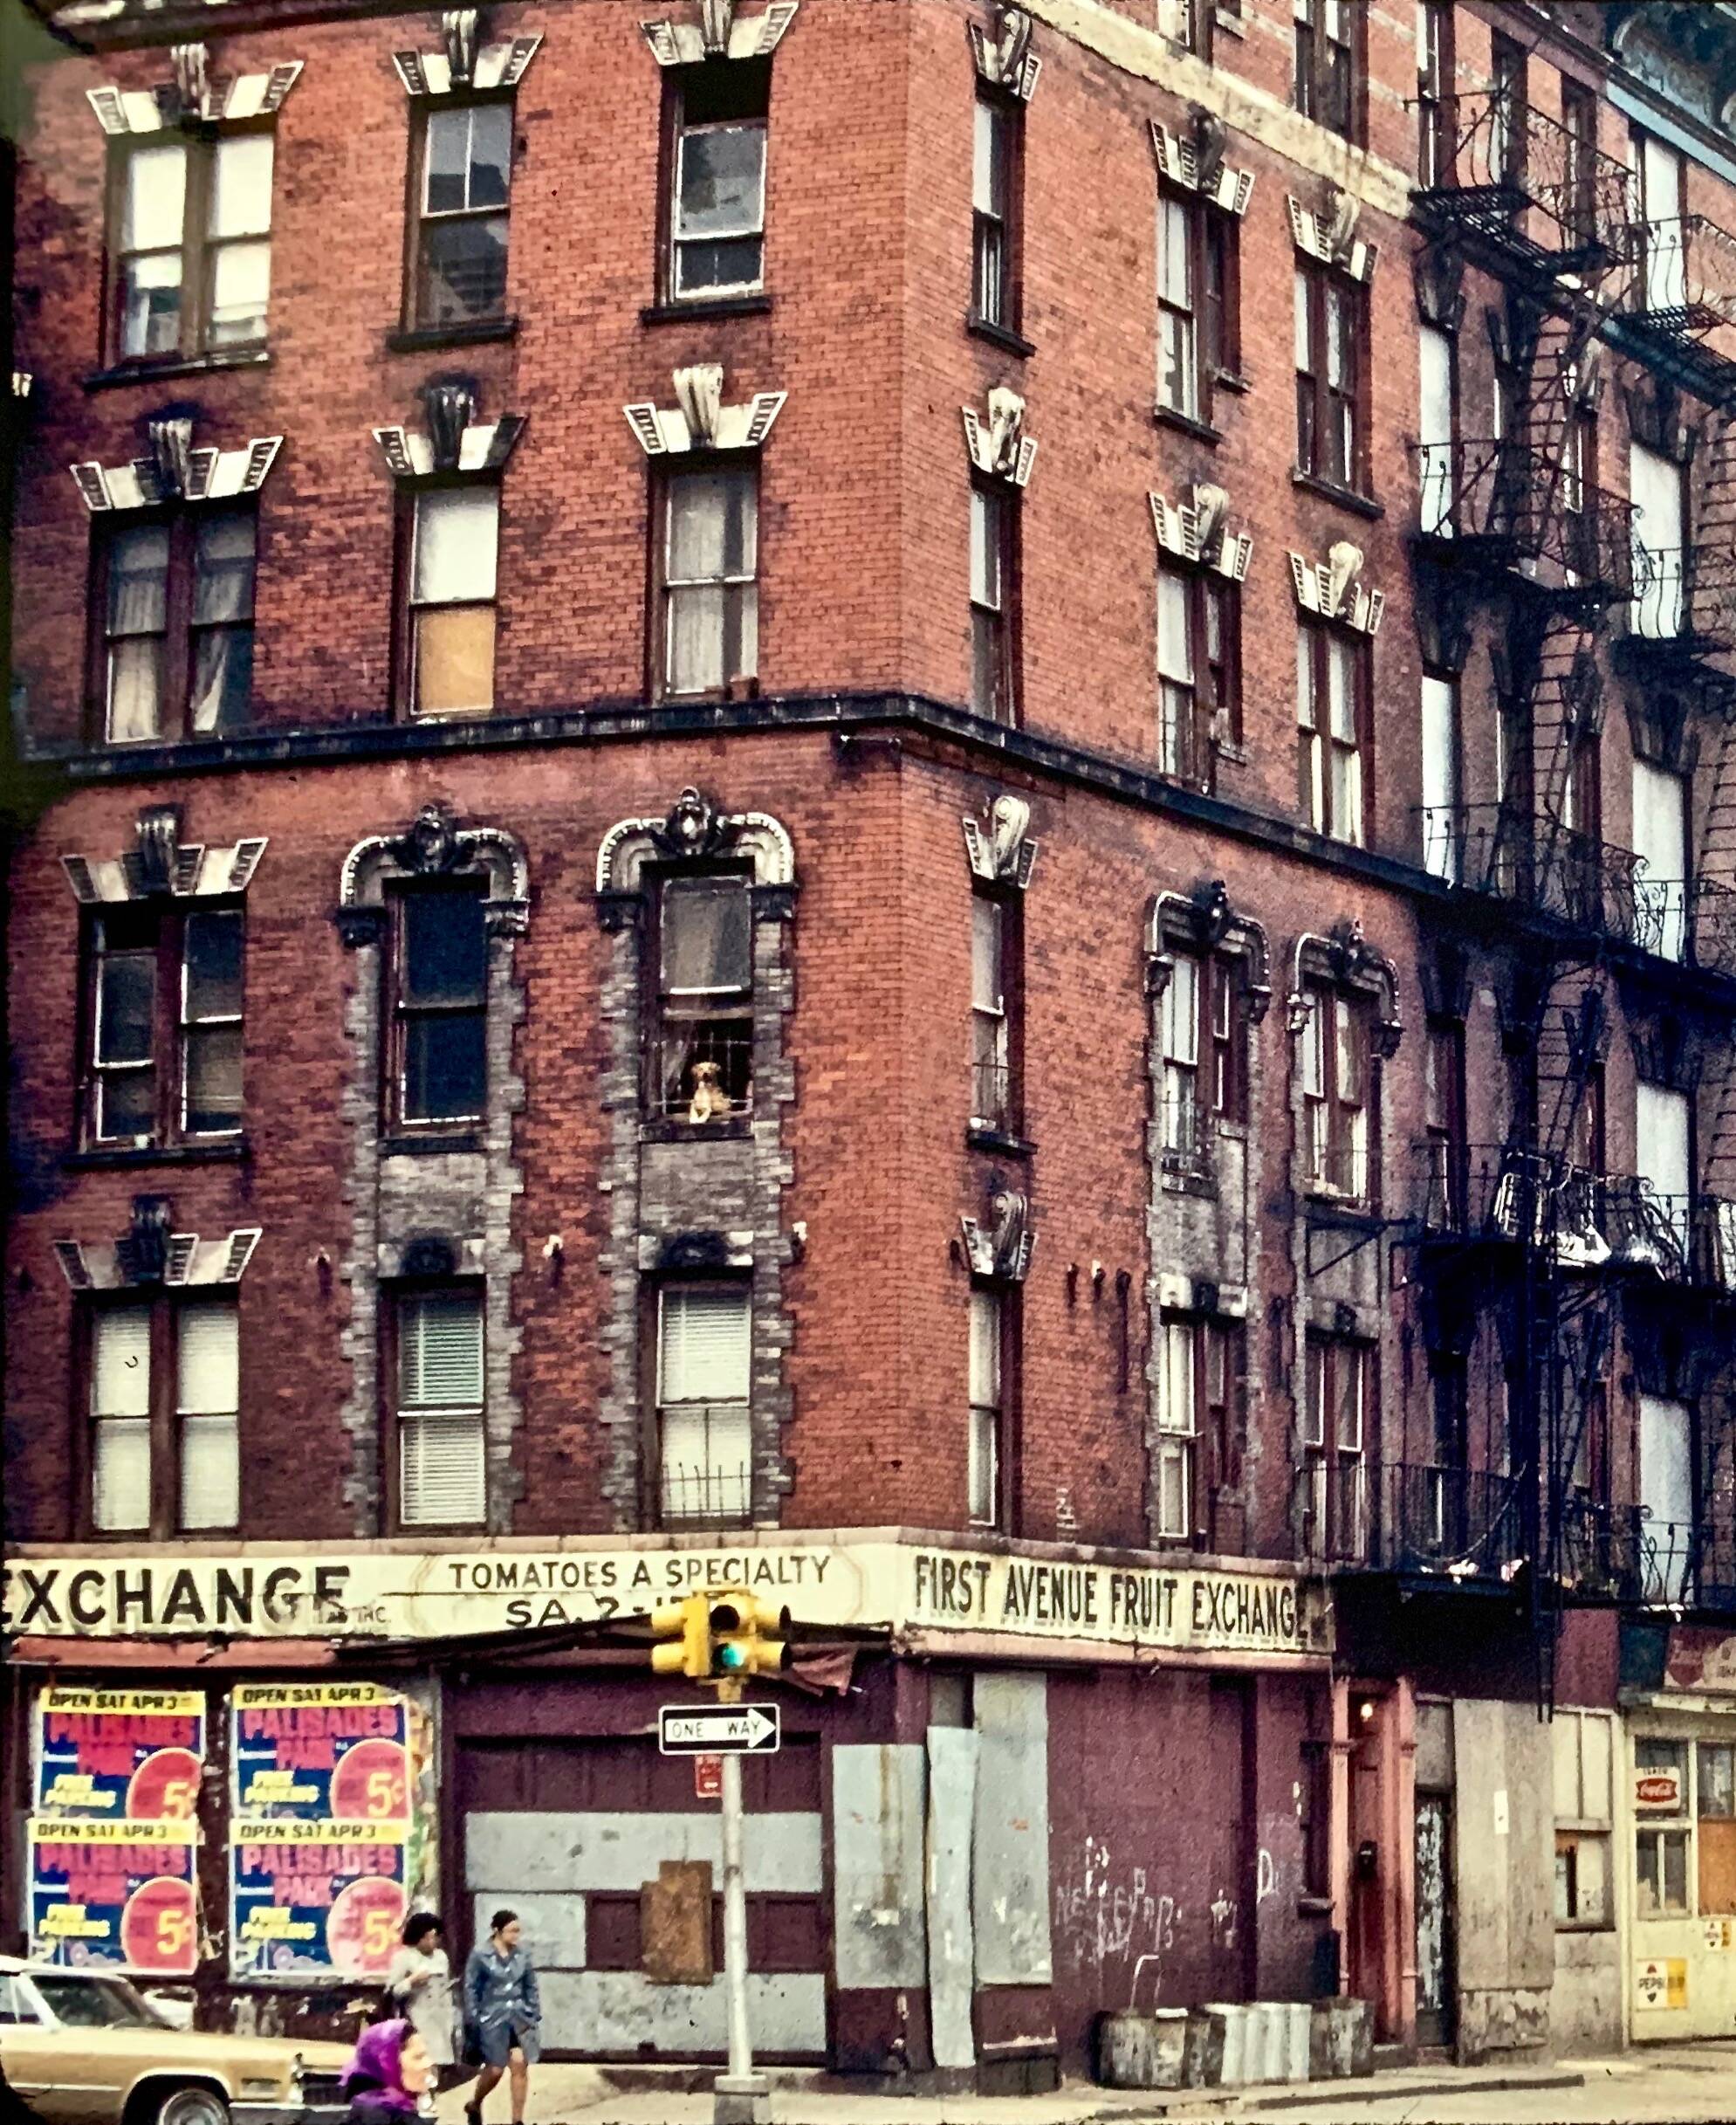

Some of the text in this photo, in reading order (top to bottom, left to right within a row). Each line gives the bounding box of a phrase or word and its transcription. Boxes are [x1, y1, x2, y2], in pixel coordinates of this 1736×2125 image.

[449, 1554, 831, 1590] TOMATOES A SPECIALTY
[916, 1555, 992, 1614] FIRST
[1005, 1564, 1098, 1624] AVENUE
[1111, 1573, 1178, 1629] FRUIT
[97, 1695, 127, 1709] SAT
[243, 1688, 287, 1703] OPEN
[327, 1688, 361, 1702] APR
[366, 1688, 376, 1701] 3
[672, 1720, 762, 1738] ONE WAY
[86, 1824, 115, 1838] SAT
[240, 1824, 377, 1839] OPEN SAT APR 3
[243, 1844, 397, 1875] PALISADES
